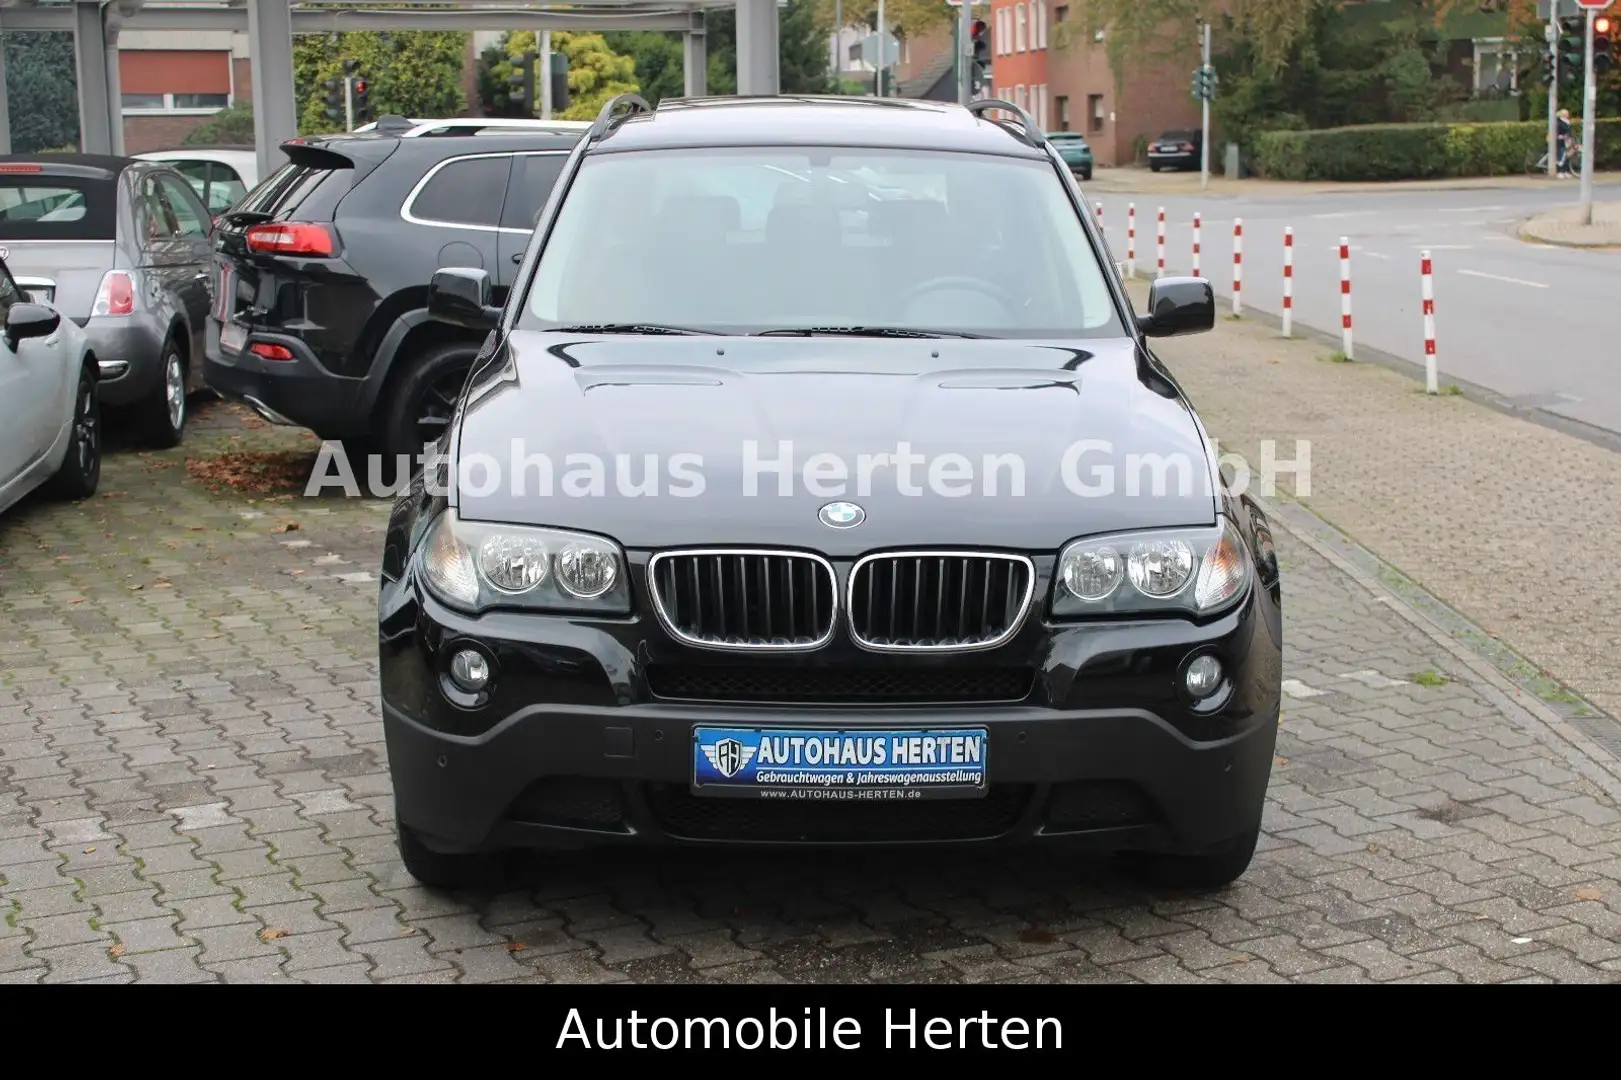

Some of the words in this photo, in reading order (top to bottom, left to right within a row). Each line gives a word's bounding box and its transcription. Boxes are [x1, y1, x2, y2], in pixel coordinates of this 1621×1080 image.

[757, 736, 887, 765] AUTOHAUS
[891, 736, 981, 764] HERTEN
[756, 771, 844, 786] Gebrauchtwagen
[846, 771, 855, 784] &
[856, 769, 982, 786] Jahreswagenausstellung
[760, 789, 921, 799] www.AUTOHAUS-HERTEN.de
